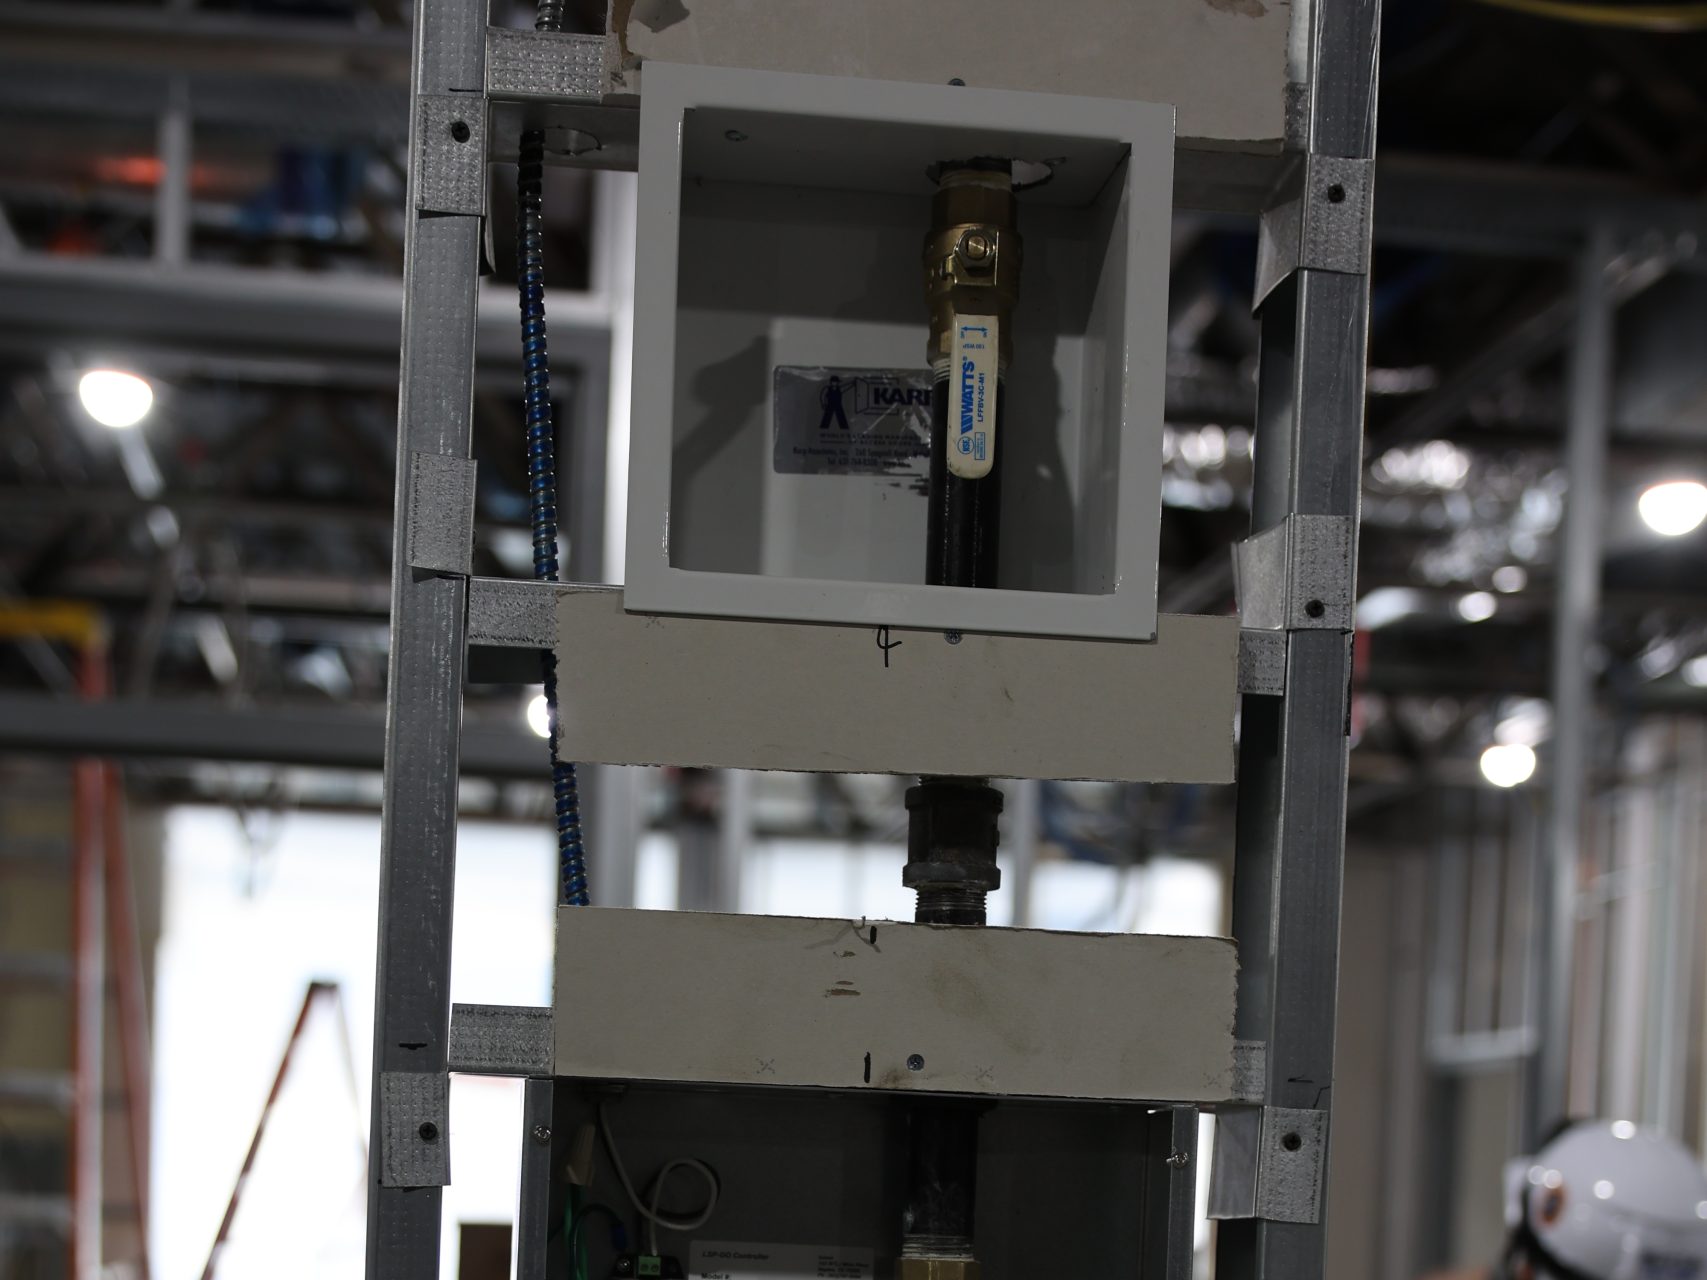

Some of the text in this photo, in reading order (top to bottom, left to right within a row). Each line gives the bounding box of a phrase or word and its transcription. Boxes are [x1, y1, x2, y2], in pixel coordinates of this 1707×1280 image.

[960, 361, 975, 416] WATTS
[961, 439, 971, 452] NSF
[701, 1272, 723, 1280] Model
